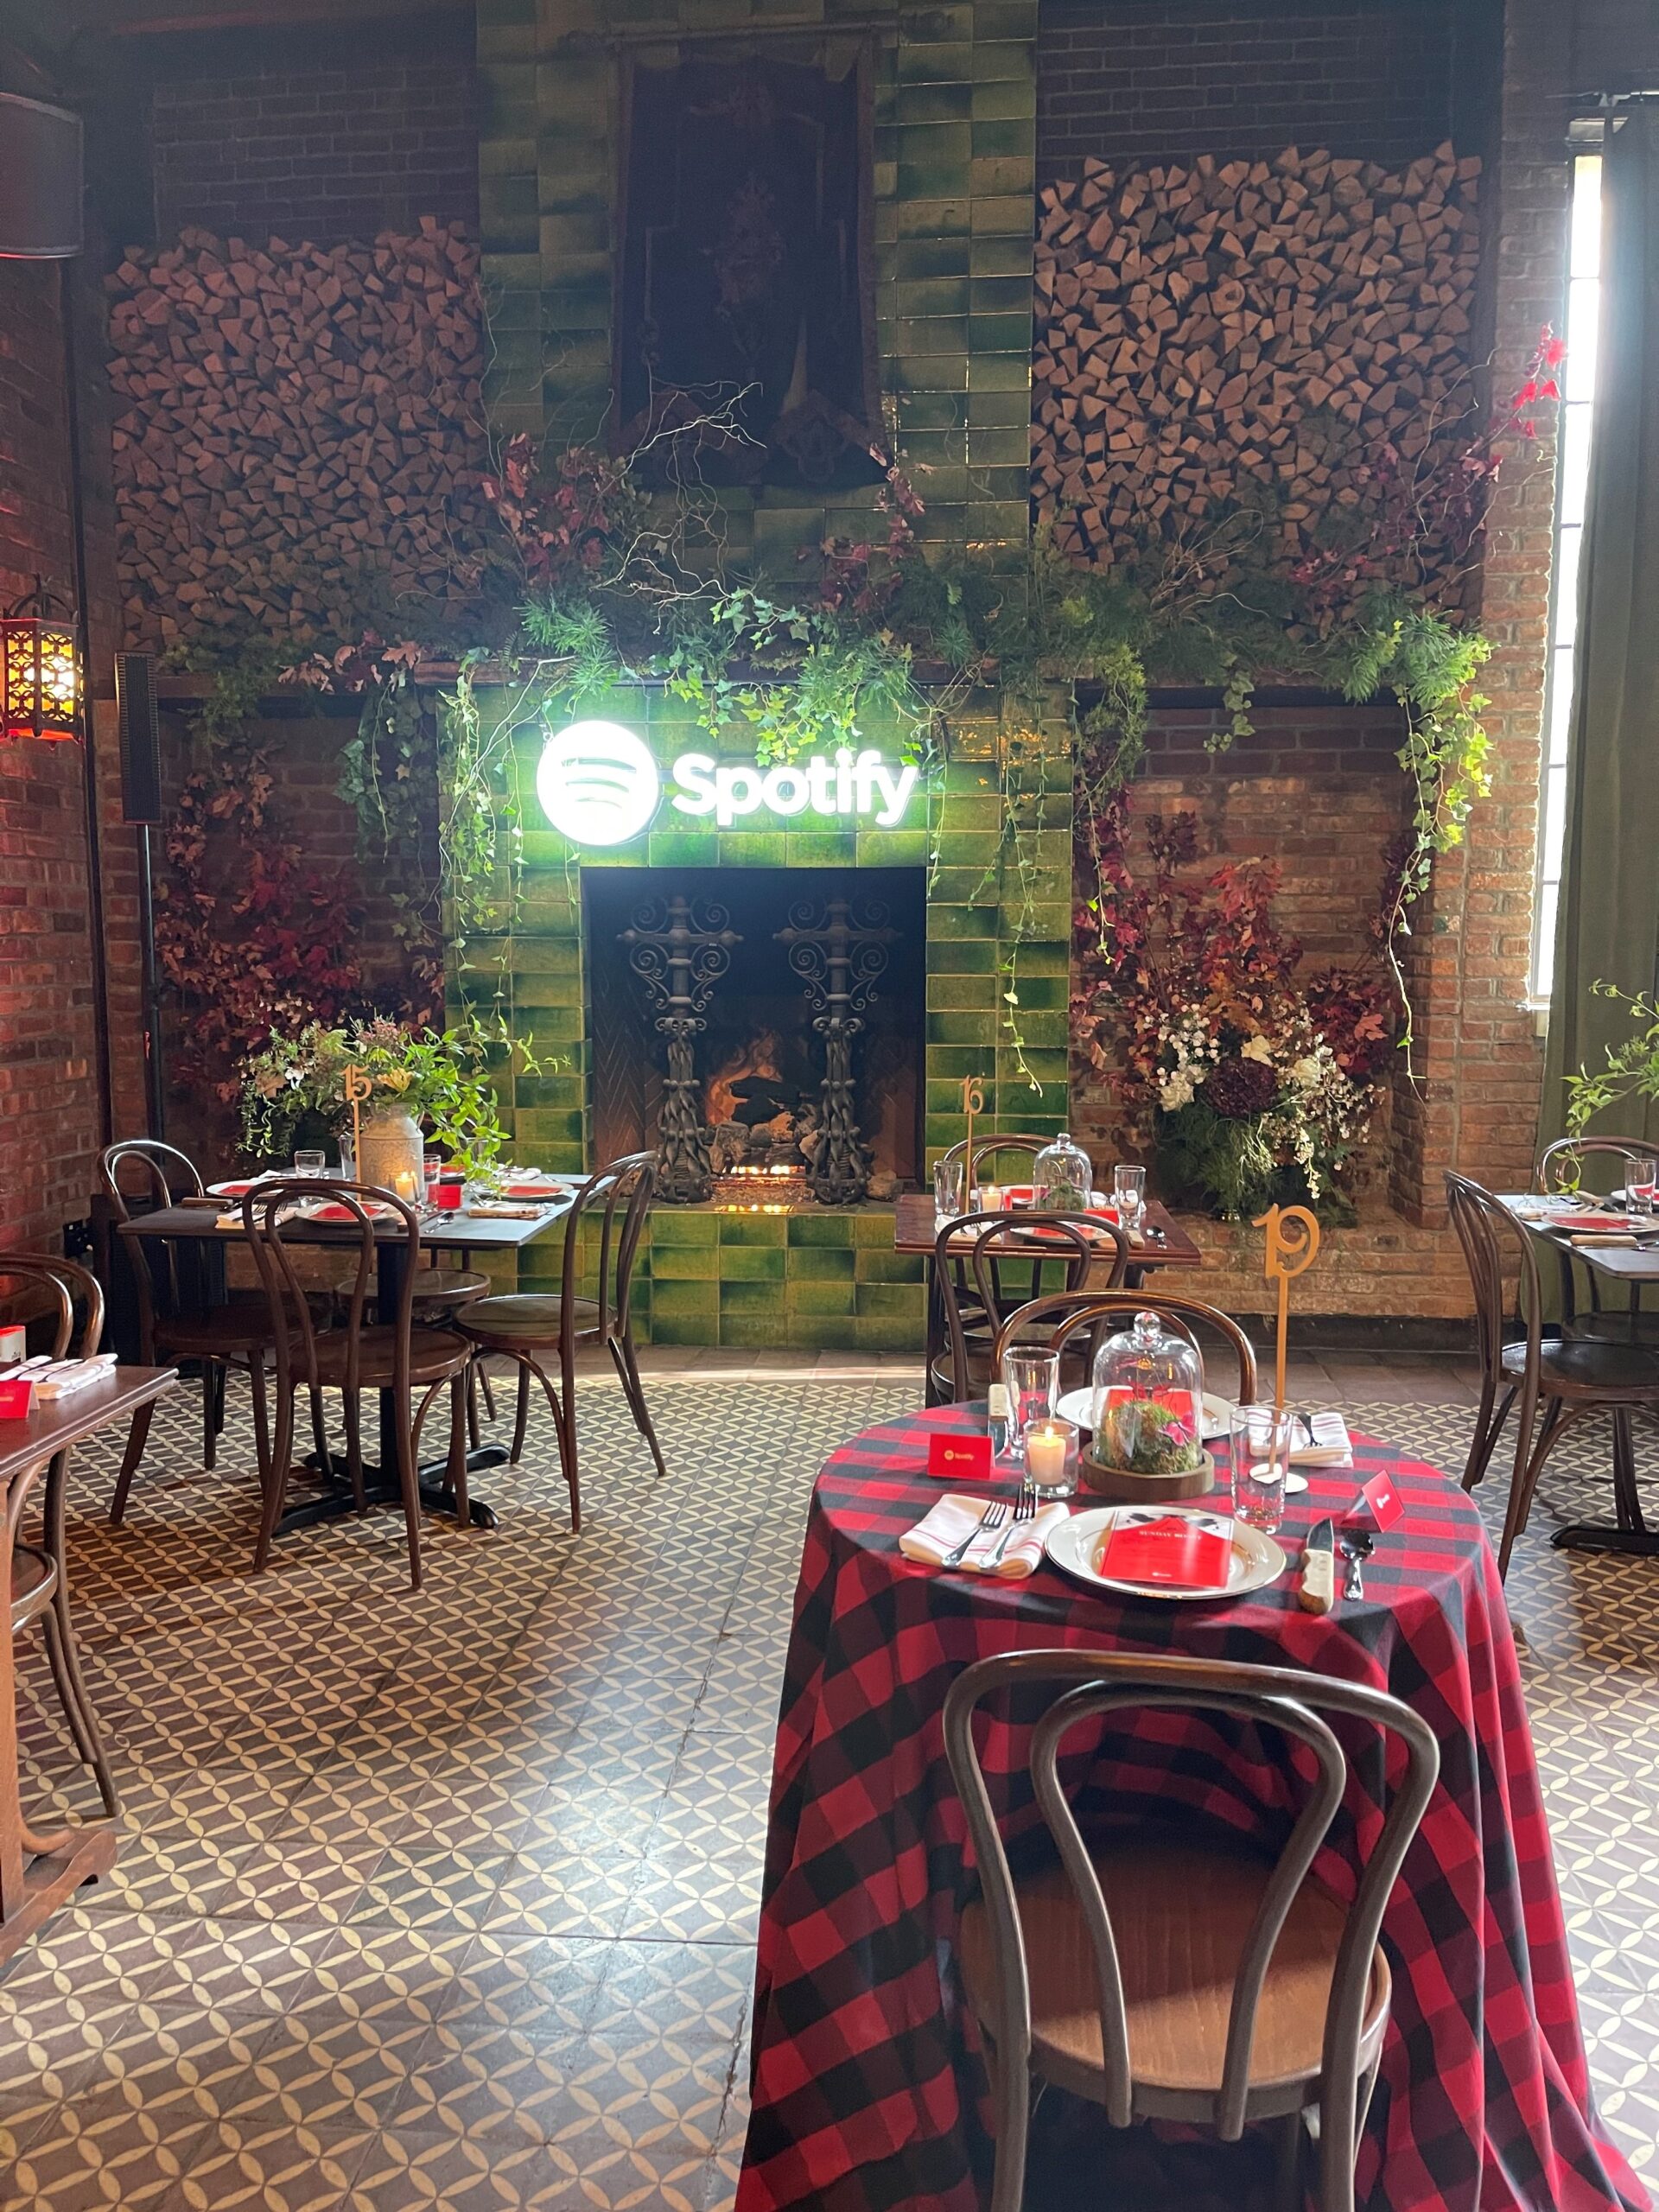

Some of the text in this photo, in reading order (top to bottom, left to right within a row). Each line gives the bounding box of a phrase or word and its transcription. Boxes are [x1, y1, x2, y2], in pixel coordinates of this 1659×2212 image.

[671, 747, 919, 827] Spotify
[340, 1064, 372, 1101] 15
[959, 1075, 983, 1114] 16
[1251, 1203, 1319, 1279] 19
